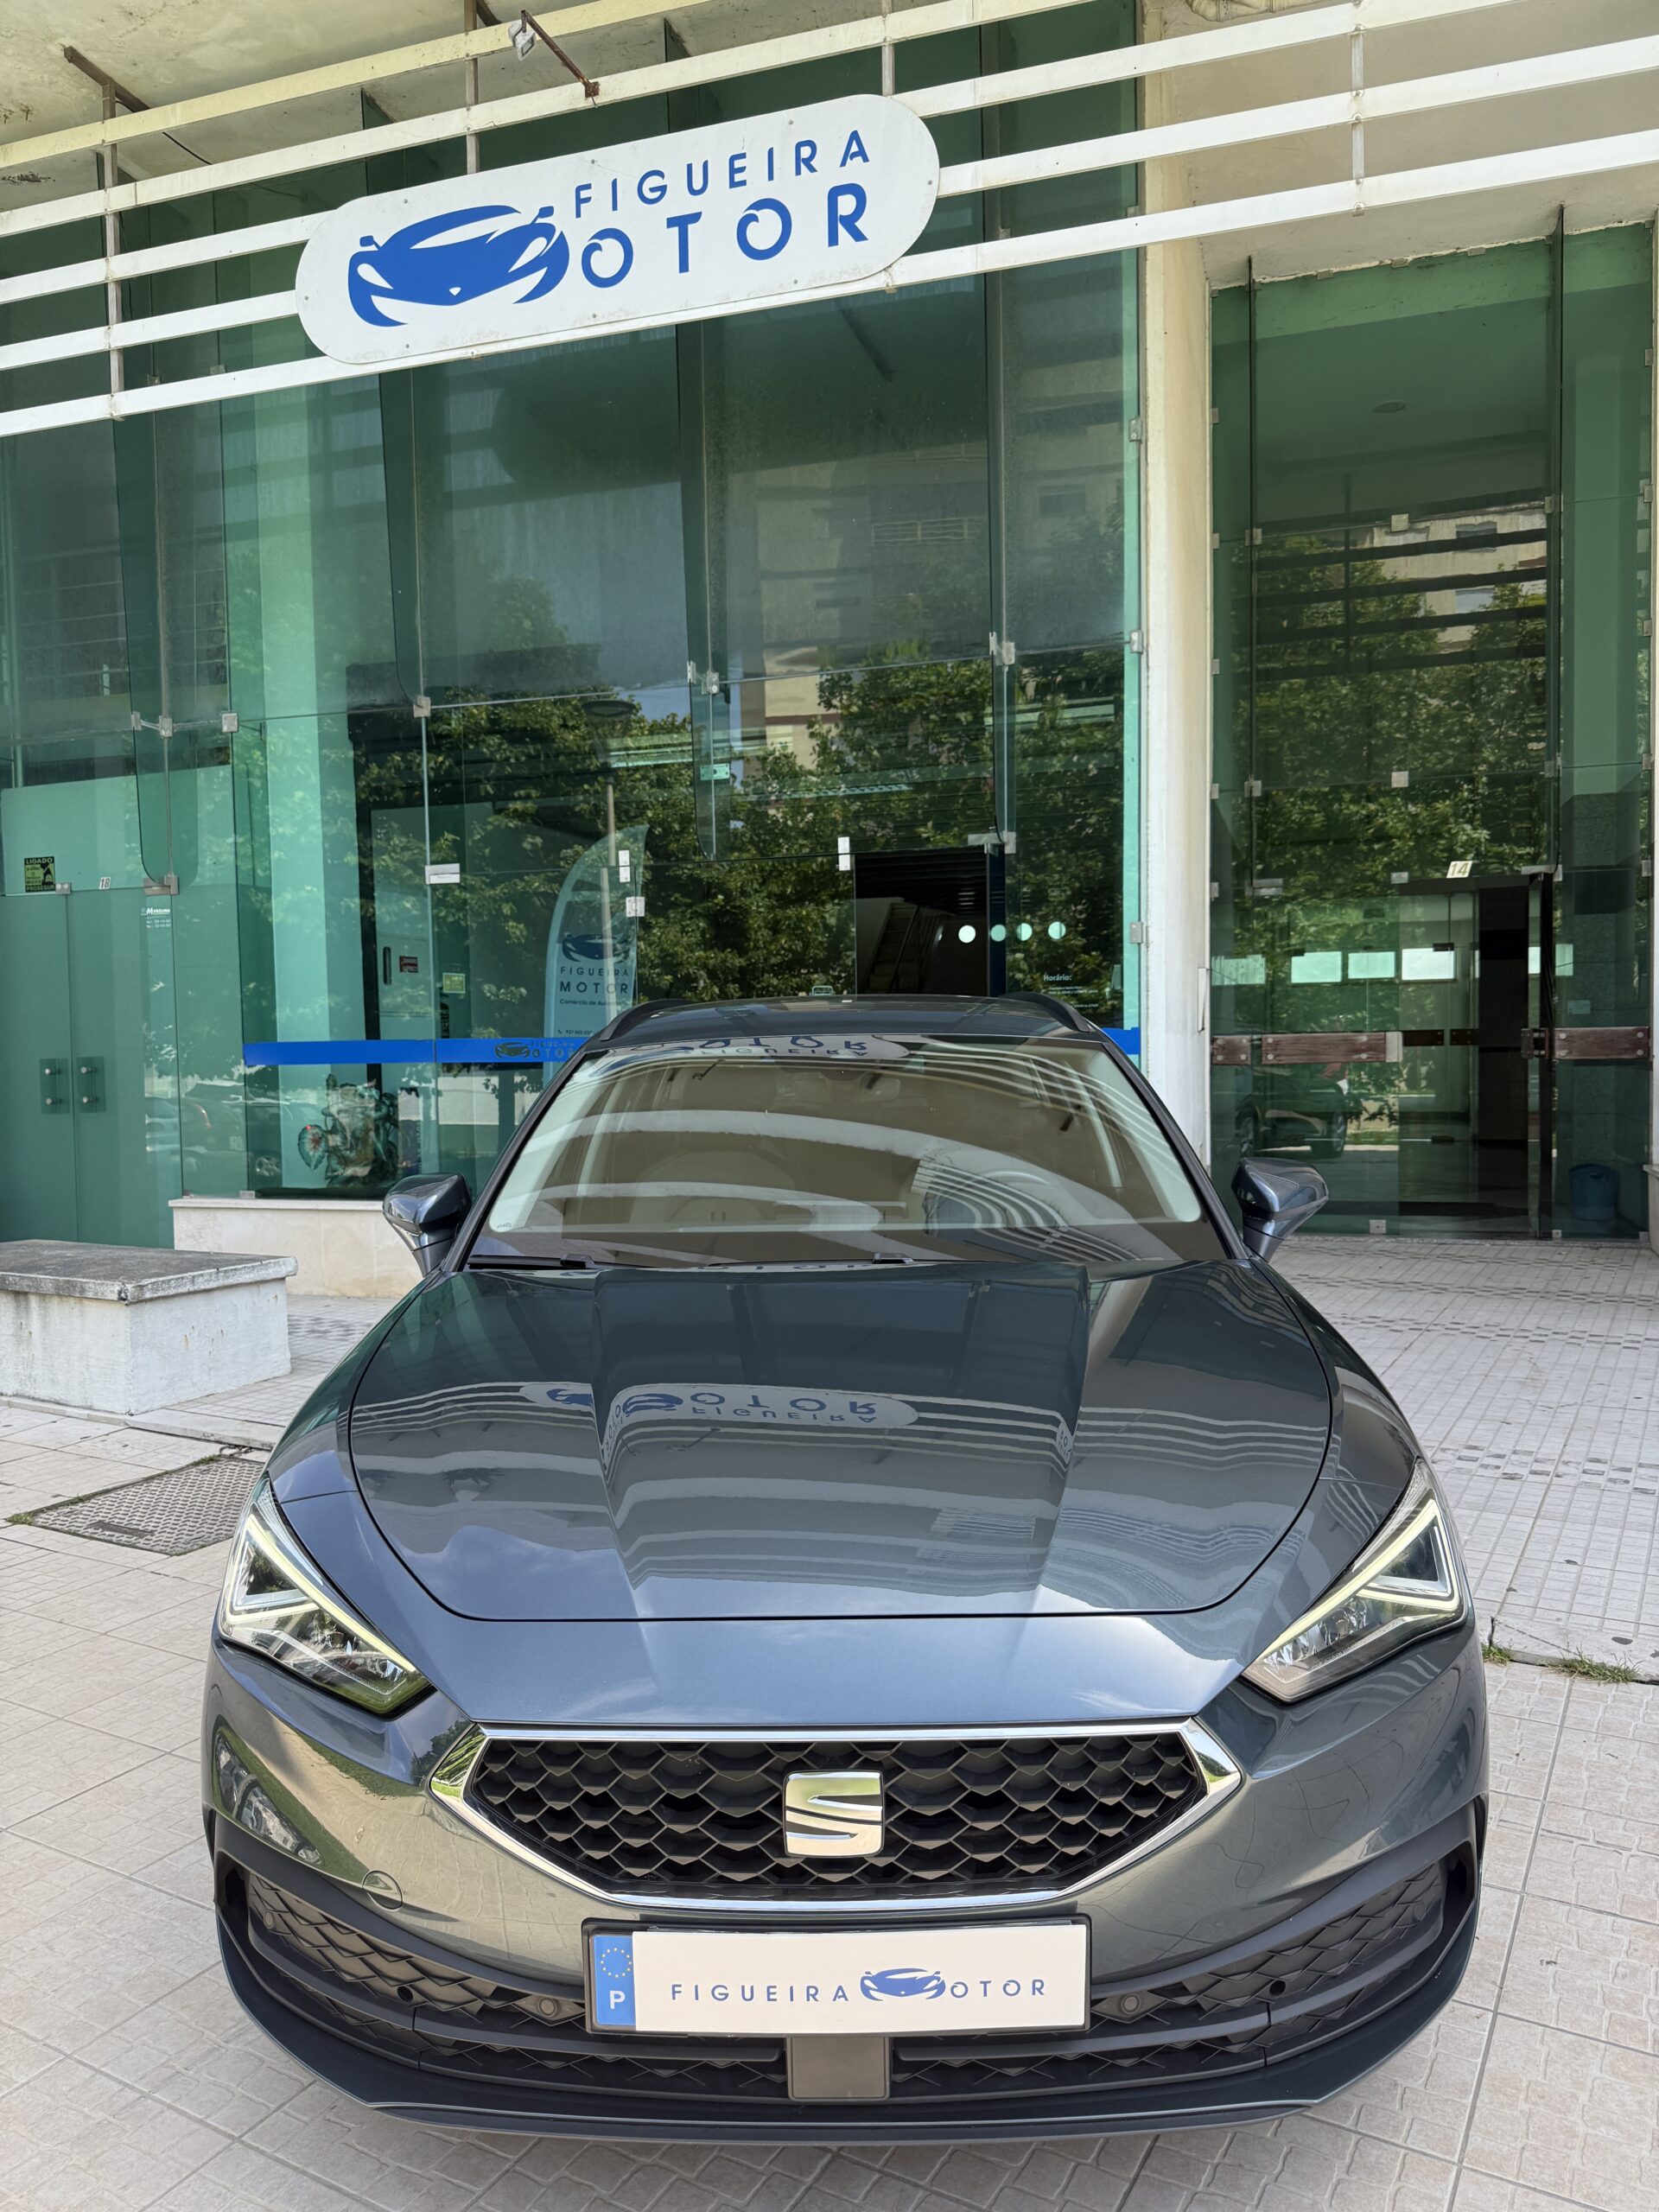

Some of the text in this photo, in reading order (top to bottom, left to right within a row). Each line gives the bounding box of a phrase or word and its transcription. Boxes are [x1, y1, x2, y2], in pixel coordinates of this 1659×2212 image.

[574, 130, 870, 219] FIGUEIRA
[1451, 862, 1469, 877] 14
[101, 877, 111, 889] 18
[560, 966, 629, 976] FIGUEIRA
[559, 981, 628, 995] MOTOR
[609, 1990, 626, 2010] P
[671, 1984, 849, 2003] FIGUEIRA
